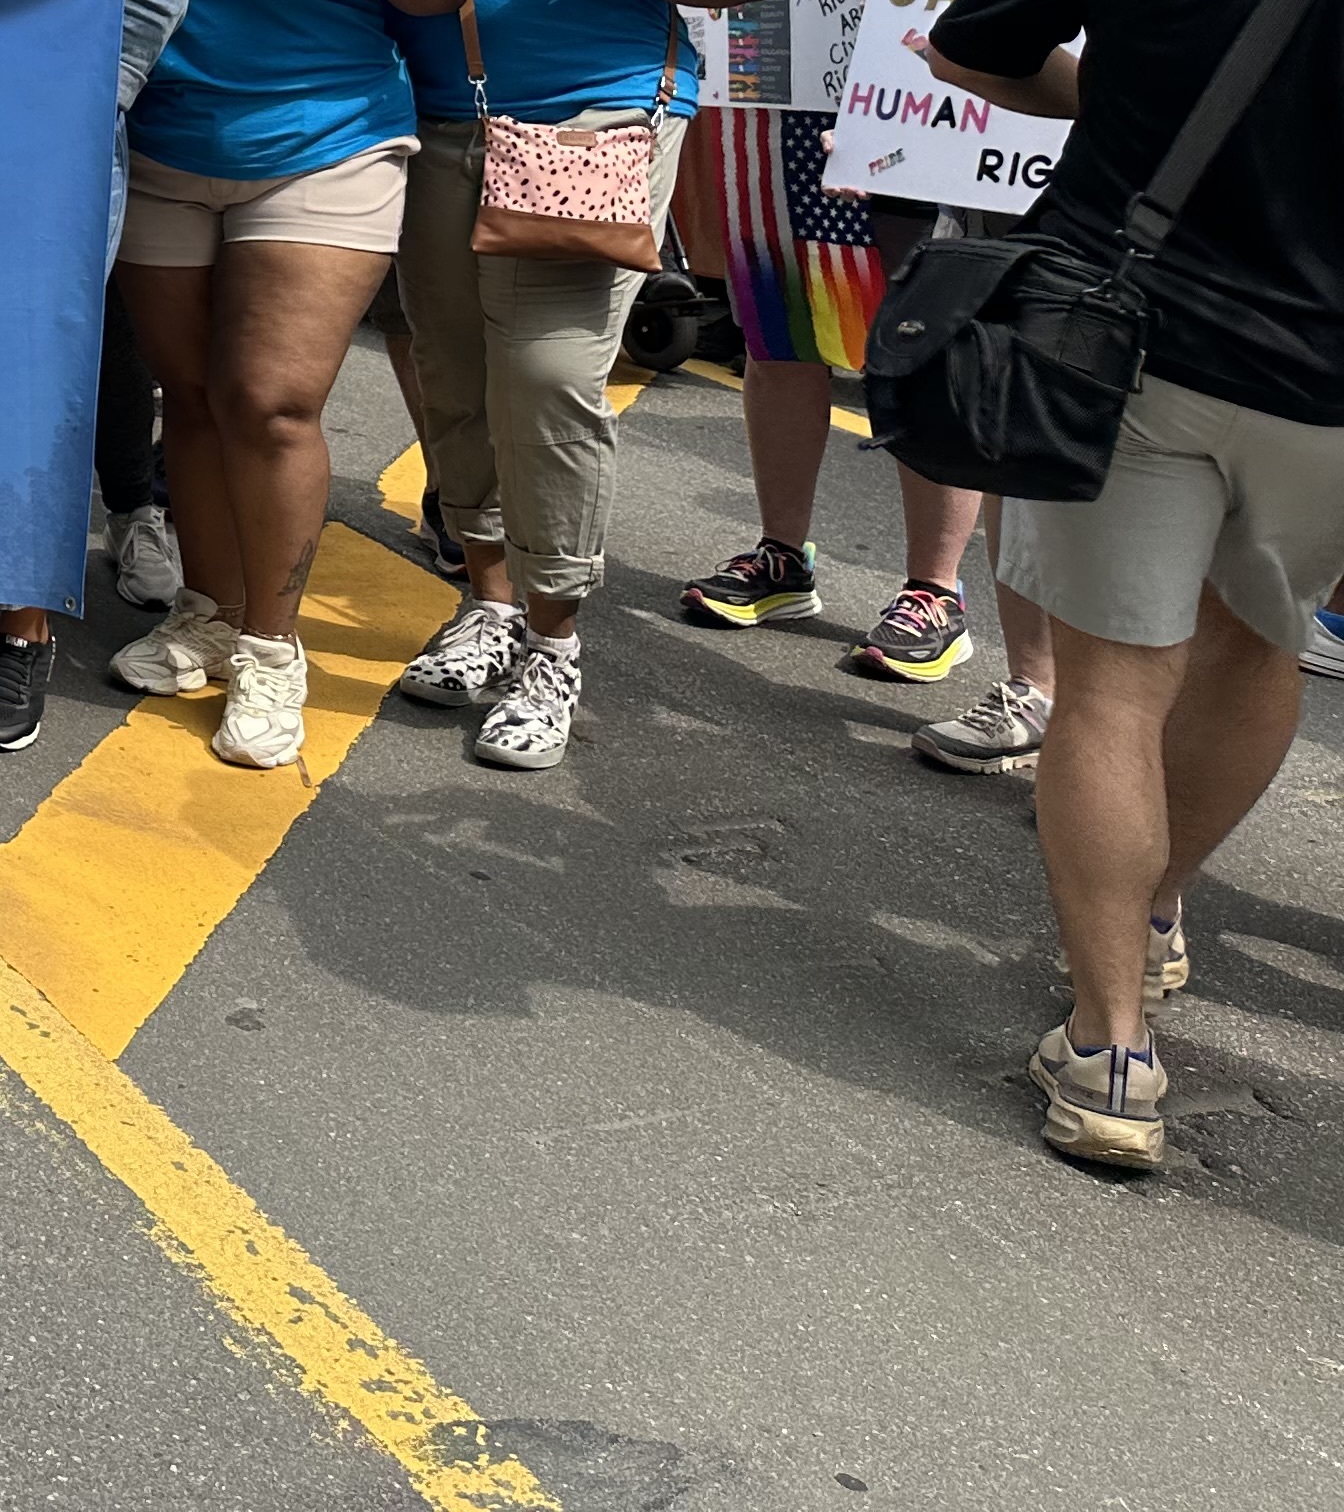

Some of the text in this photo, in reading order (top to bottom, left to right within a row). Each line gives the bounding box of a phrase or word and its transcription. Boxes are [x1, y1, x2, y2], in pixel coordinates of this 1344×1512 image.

[847, 82, 992, 134] HUMAN
[868, 147, 906, 177] PRIDE
[976, 148, 1055, 189] RIG
